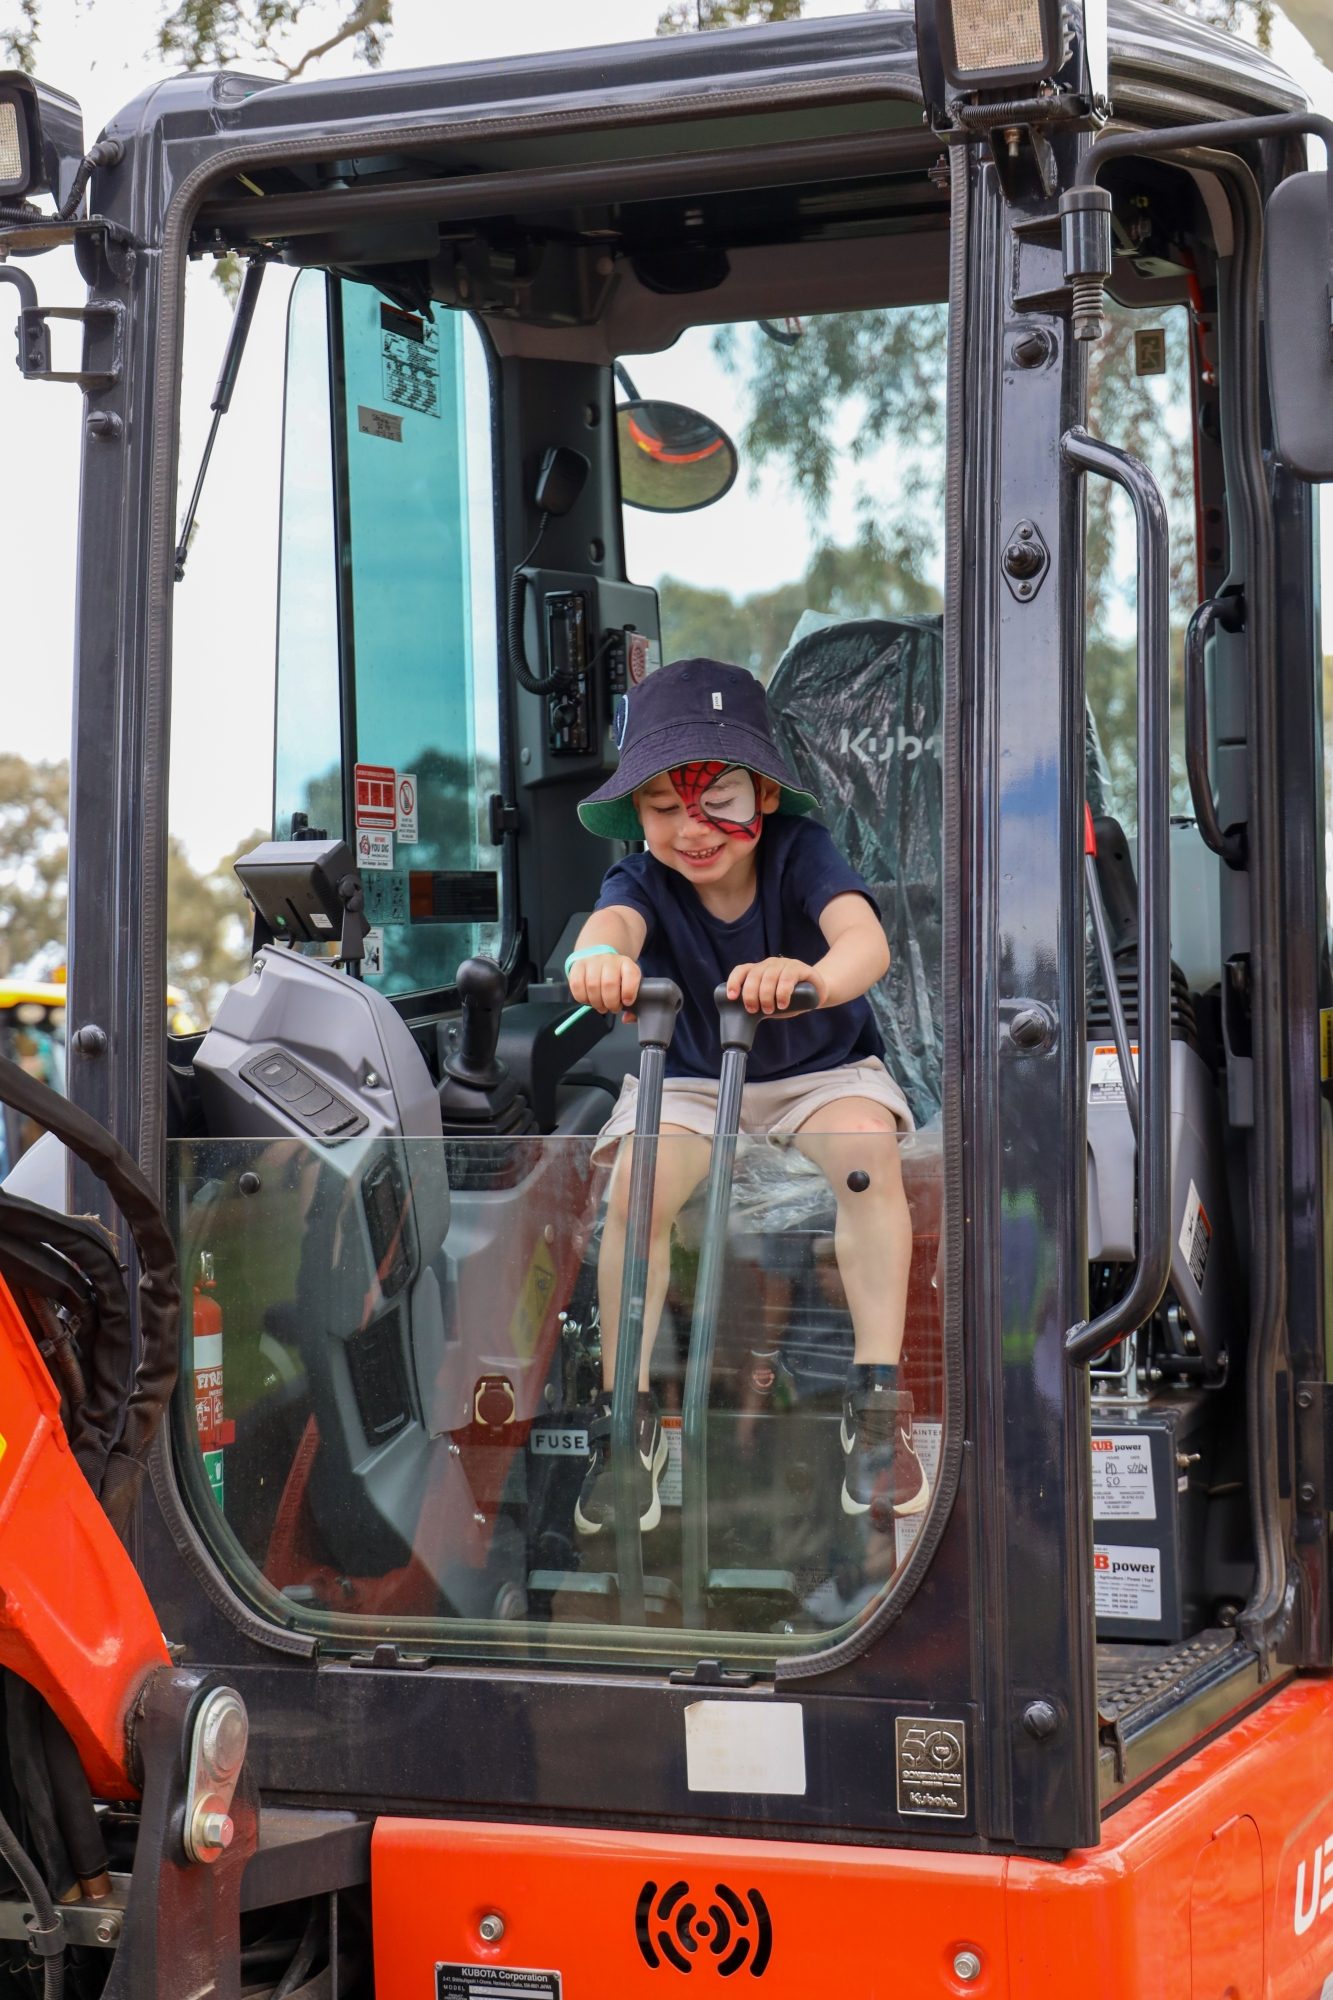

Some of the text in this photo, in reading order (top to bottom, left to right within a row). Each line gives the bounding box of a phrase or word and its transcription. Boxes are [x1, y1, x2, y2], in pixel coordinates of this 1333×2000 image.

[536, 1435, 584, 1449] FUSE
[1115, 1444, 1141, 1452] power
[1112, 1562, 1155, 1573] power
[902, 1728, 960, 1770] 50
[461, 1967, 548, 1982] KUBOTA Corporation
